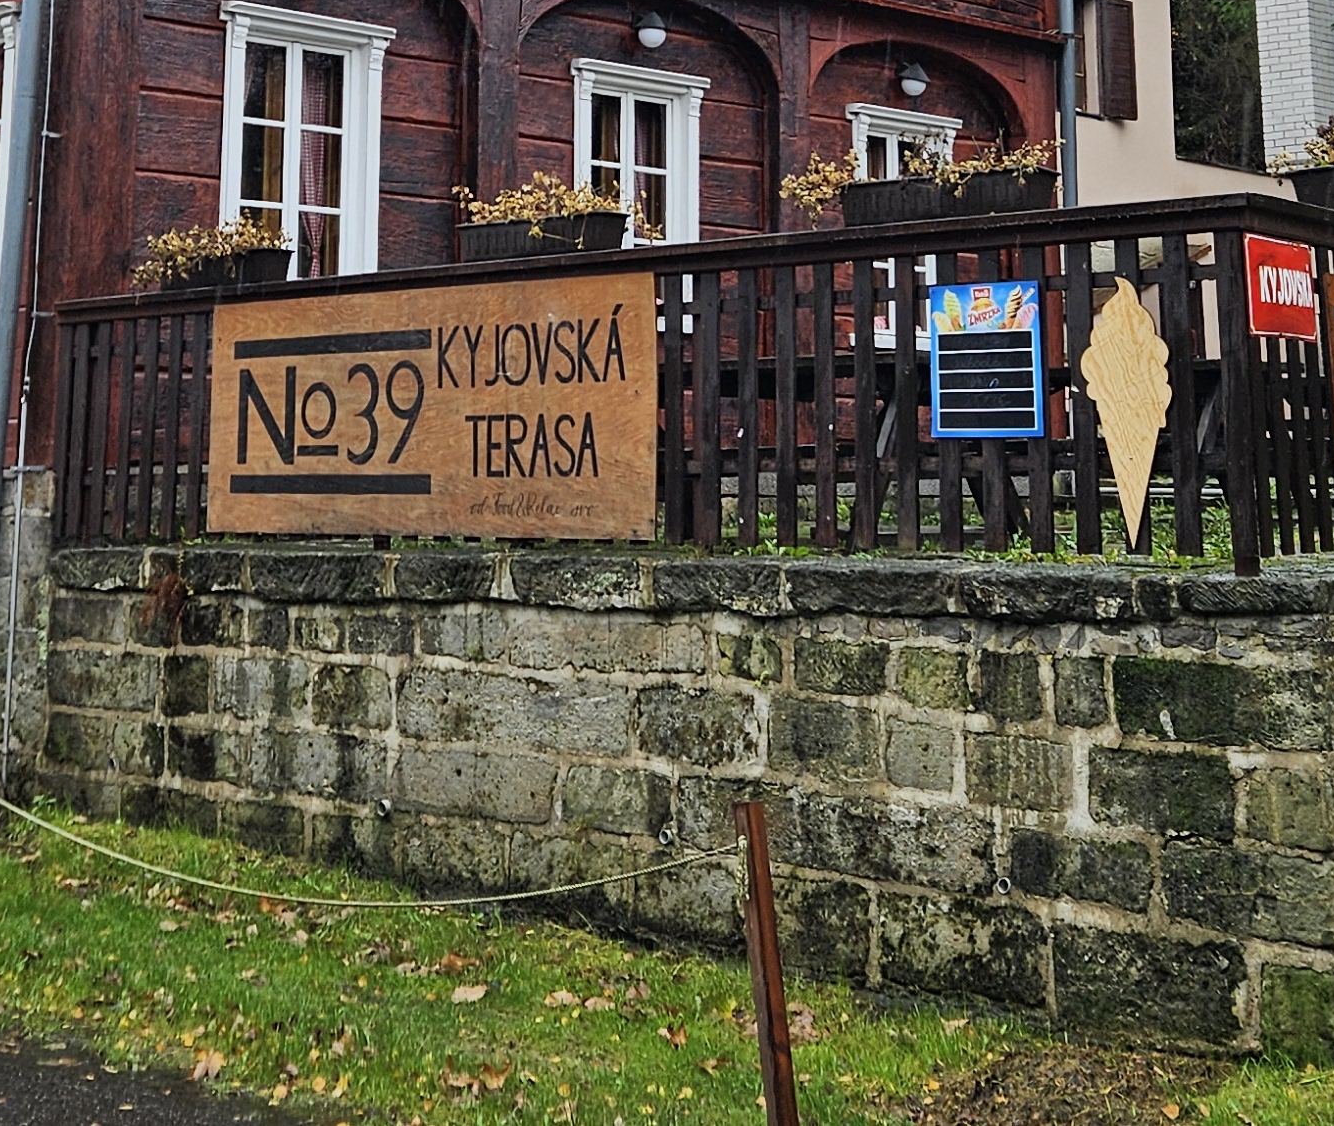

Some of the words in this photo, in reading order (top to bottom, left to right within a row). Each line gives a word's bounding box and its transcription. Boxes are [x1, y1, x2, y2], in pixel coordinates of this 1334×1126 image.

[1258, 263, 1314, 309] KYJOVSKÁ
[436, 304, 627, 389] KYJOVSKÁ
[464, 411, 600, 479] TERASA
